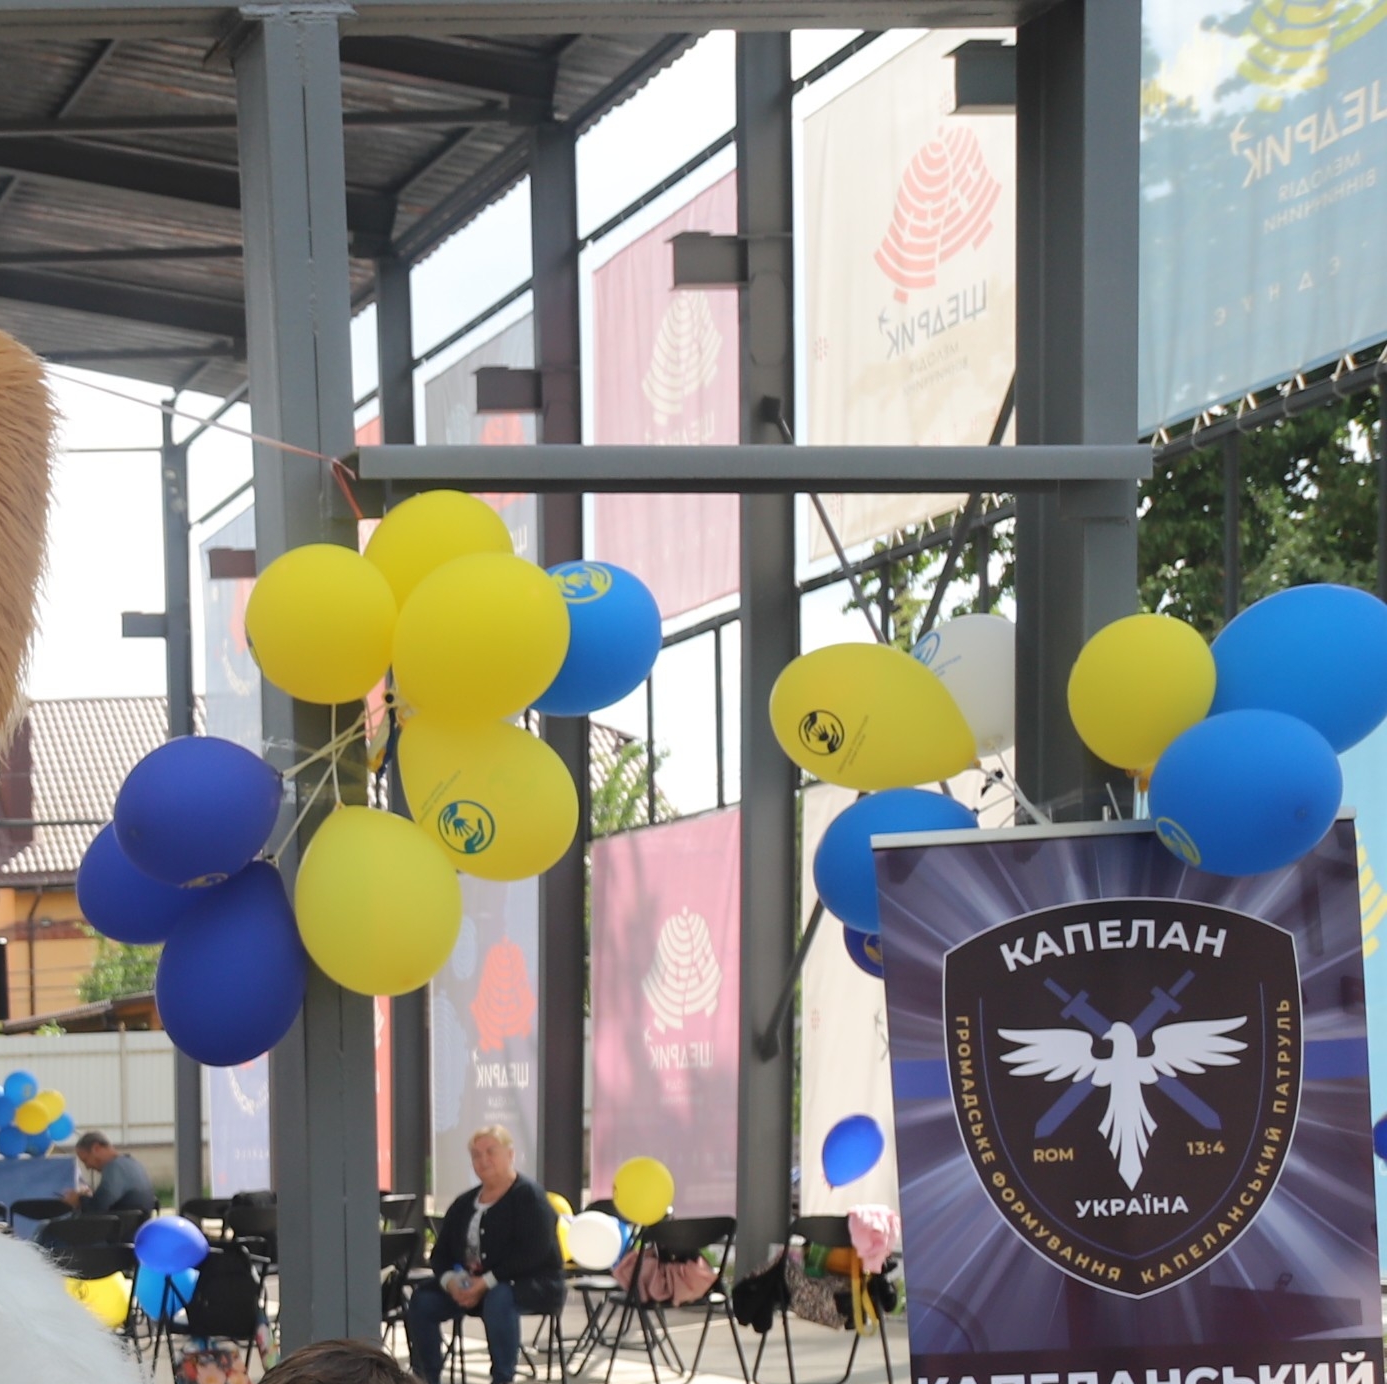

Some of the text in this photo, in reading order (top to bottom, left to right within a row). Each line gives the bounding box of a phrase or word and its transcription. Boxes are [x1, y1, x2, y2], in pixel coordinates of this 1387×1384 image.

[999, 918, 1228, 973] КАПЕЛАН
[955, 999, 1292, 1285] ГРОМАДСЬКЕ ФОРМУВАННЯ КАПЕЛАНСЬКИЙ ПАТРУЛЬ
[1033, 1141, 1226, 1163] ROM 13:4
[1075, 1193, 1190, 1220] УКРАЇНА
